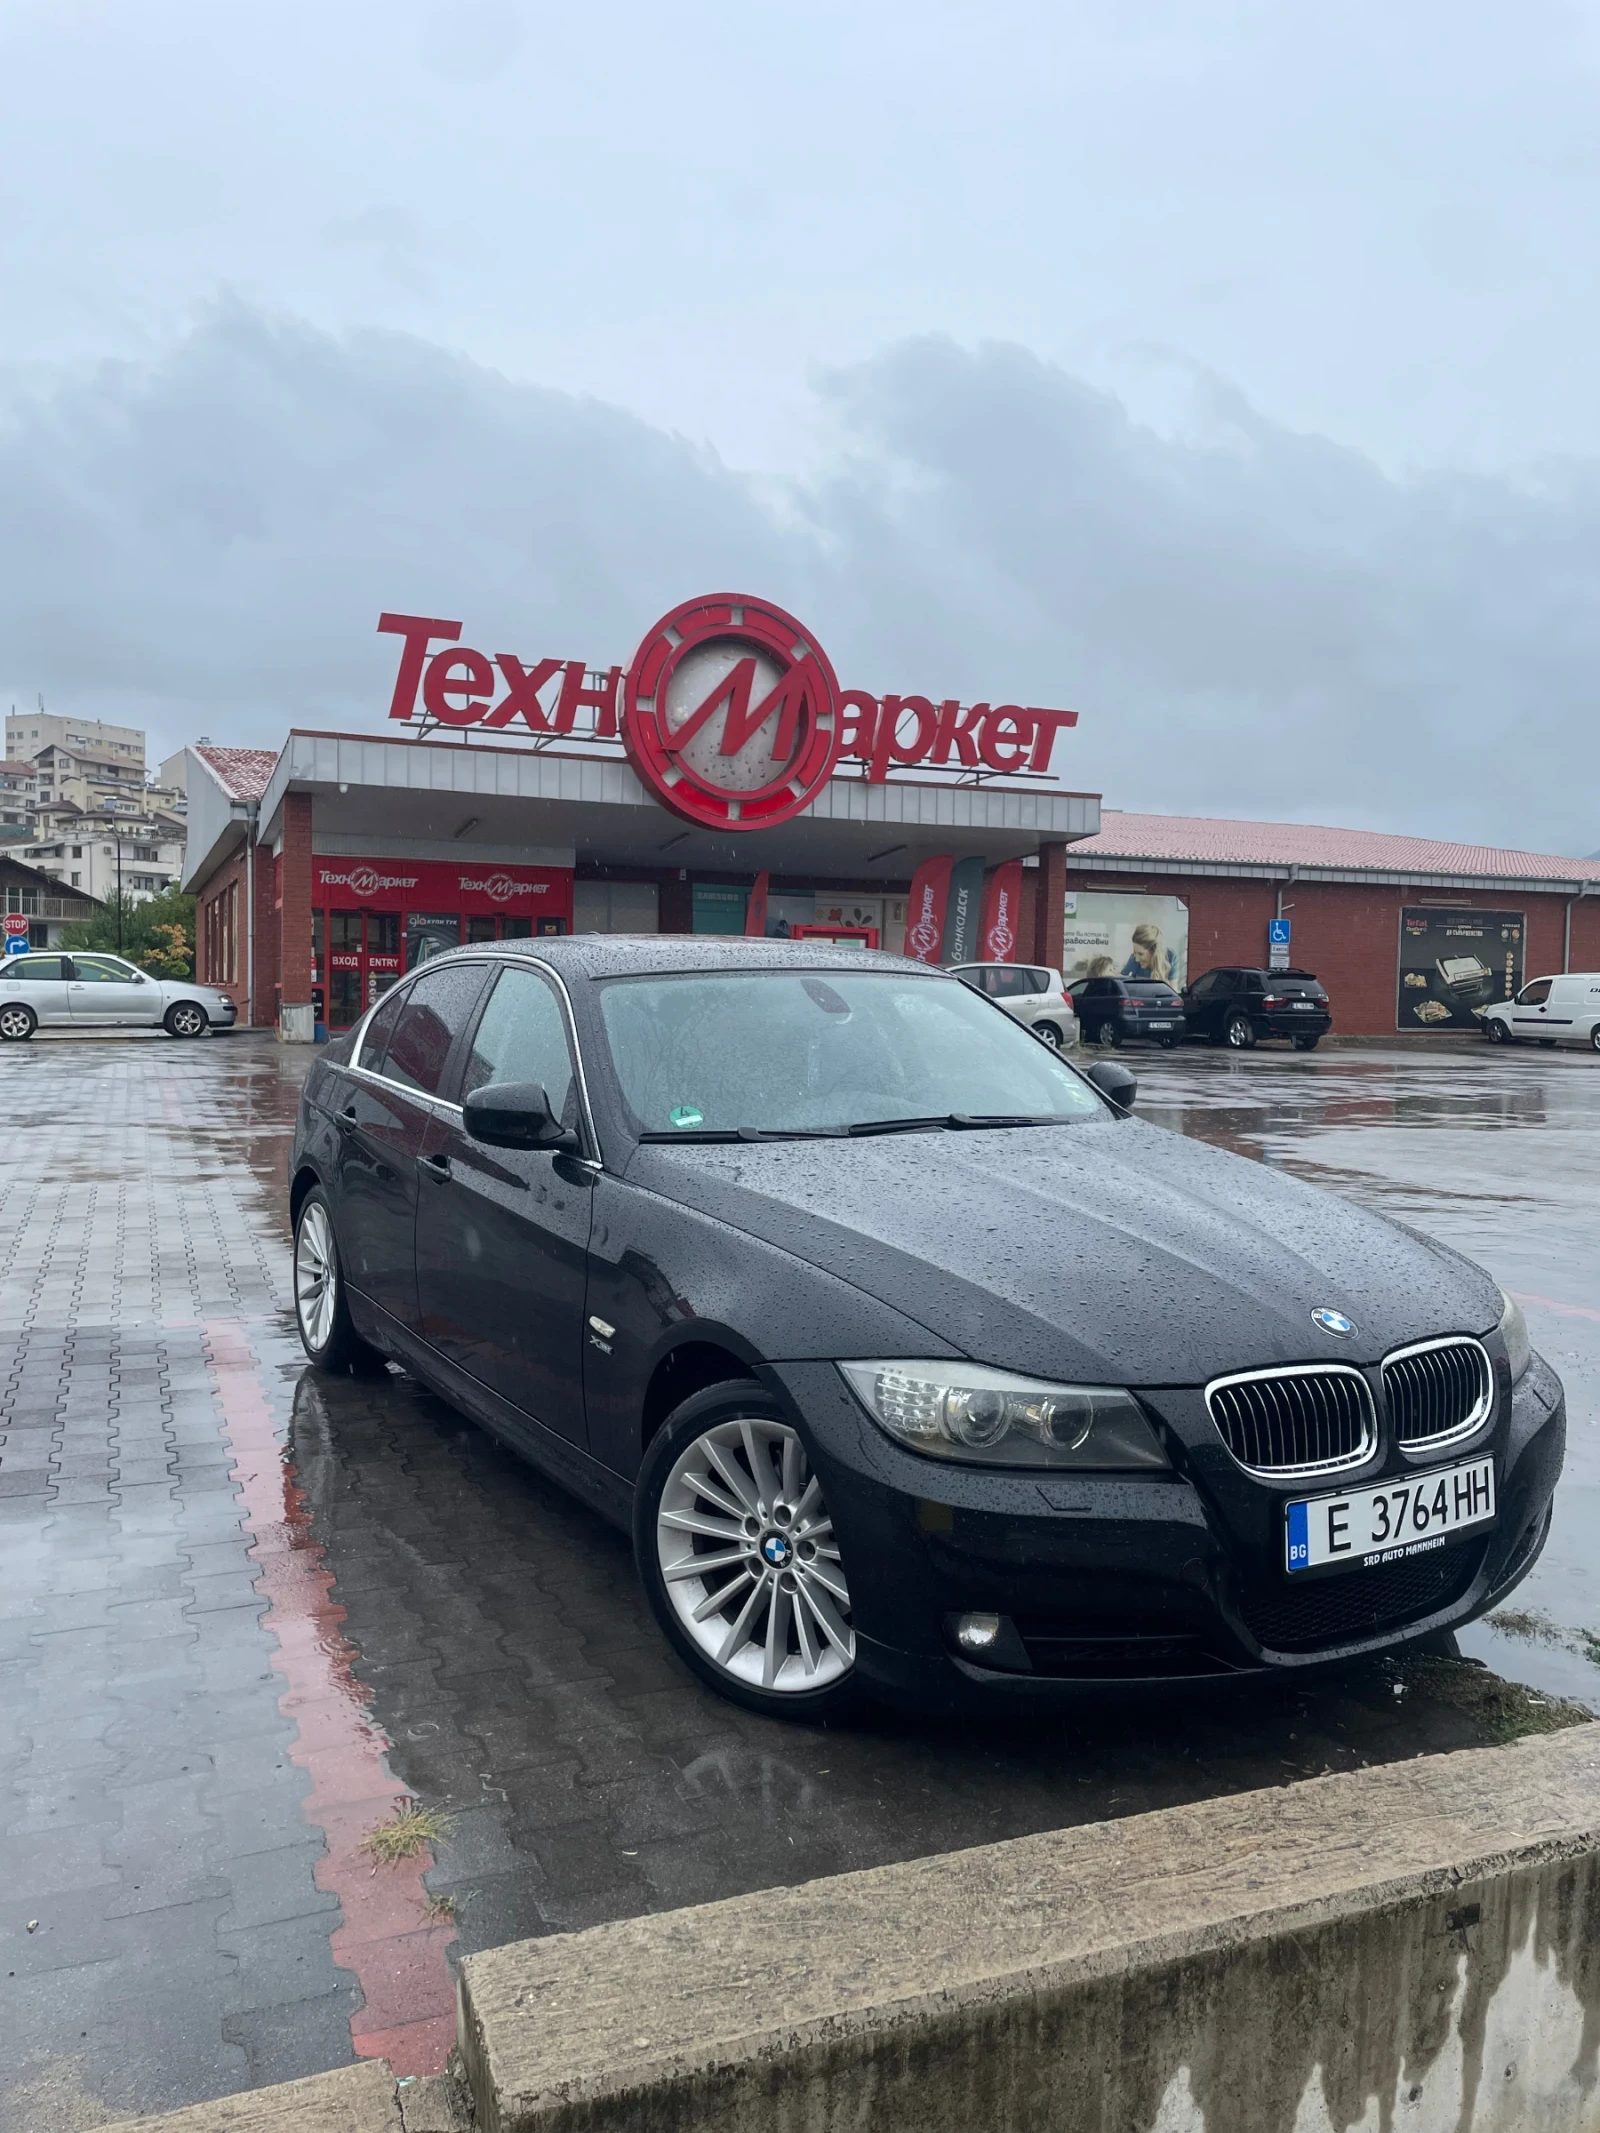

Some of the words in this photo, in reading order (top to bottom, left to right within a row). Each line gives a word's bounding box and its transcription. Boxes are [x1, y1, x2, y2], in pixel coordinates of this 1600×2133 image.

[697, 891, 739, 901] SAMSUNG
[5, 920, 26, 929] STOP
[409, 913, 427, 927] glo
[1064, 937, 1109, 945] равословни
[332, 956, 358, 967] ВХОД
[369, 957, 399, 967] ENTRY
[1328, 1503, 1351, 1554] E
[1371, 1478, 1448, 1543] 3764
[1453, 1466, 1490, 1521] HH
[1290, 1544, 1307, 1560] BG
[1363, 1554, 1380, 1567] SRD
[1382, 1547, 1404, 1562] AUTO
[1405, 1535, 1446, 1556] MANNHEIM
